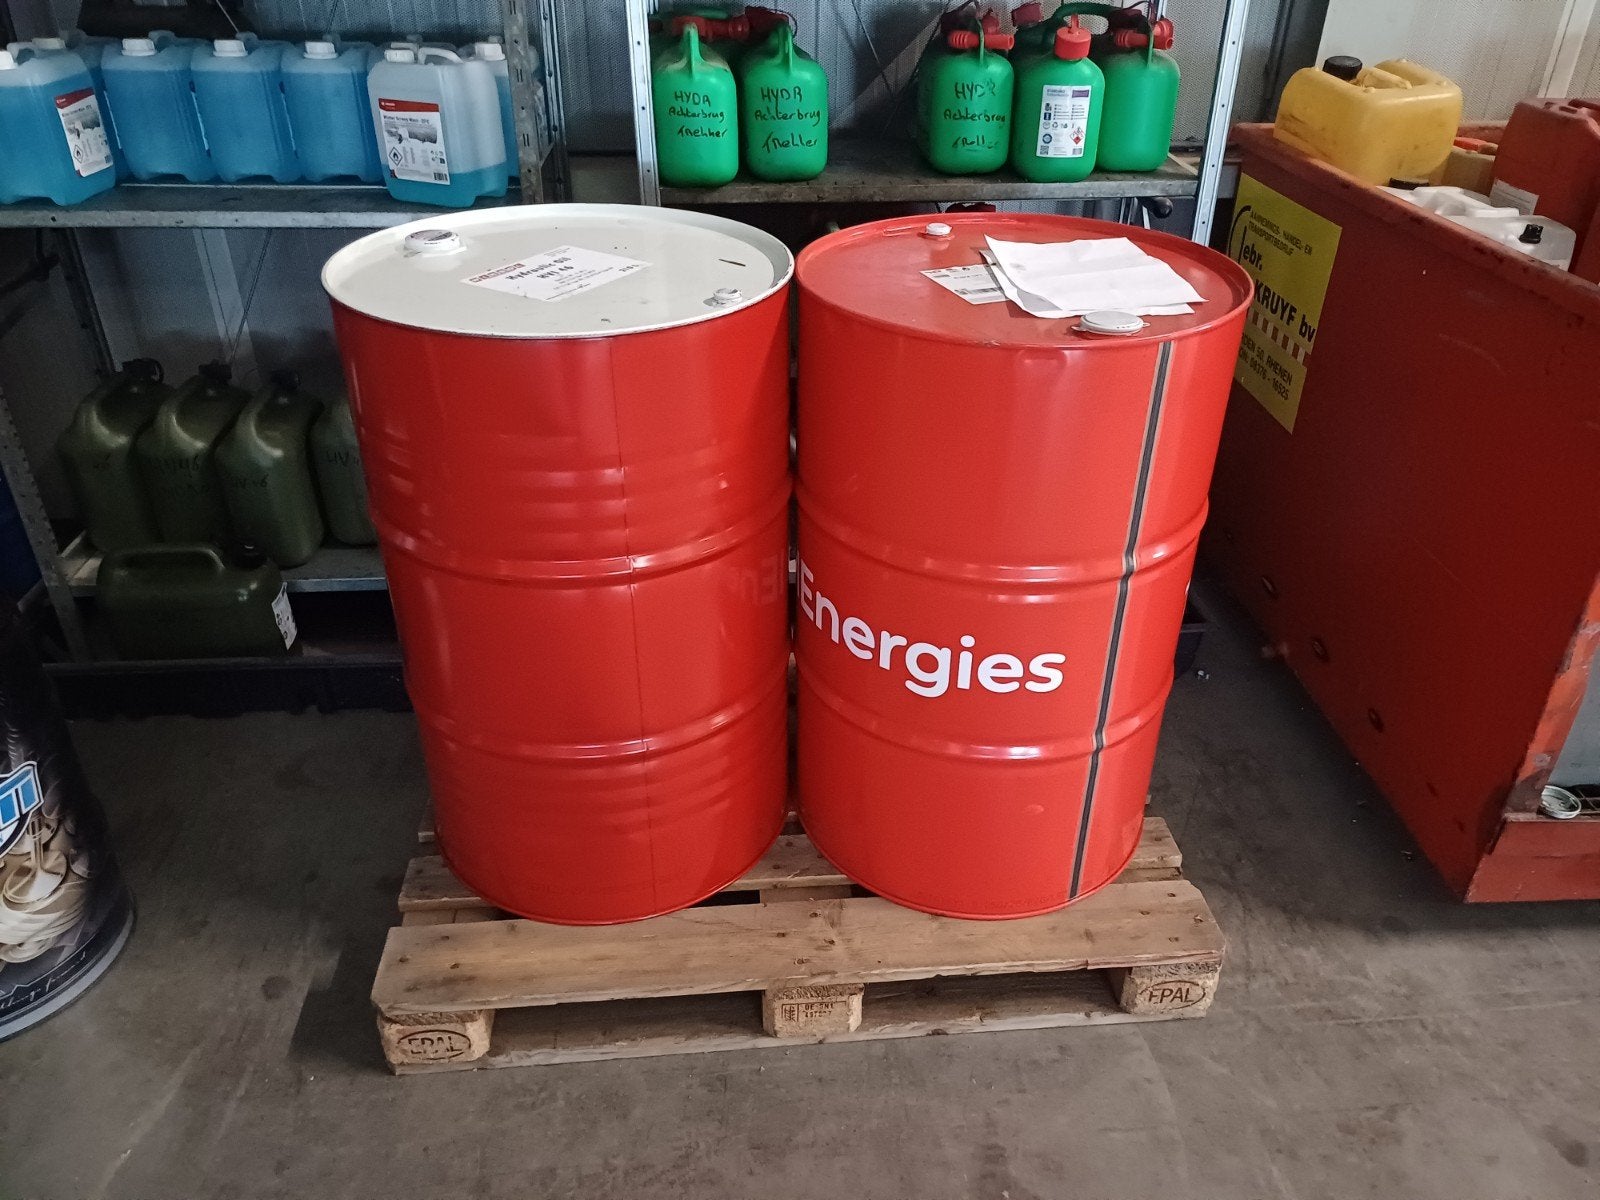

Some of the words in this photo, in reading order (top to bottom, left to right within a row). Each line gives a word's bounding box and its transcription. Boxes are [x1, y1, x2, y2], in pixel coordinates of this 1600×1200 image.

[761, 86, 803, 103] HYDR
[1299, 314, 1316, 343] bv
[1265, 355, 1293, 386] RHENEN
[800, 558, 1066, 698] Energies
[1148, 988, 1194, 1004] EPAL
